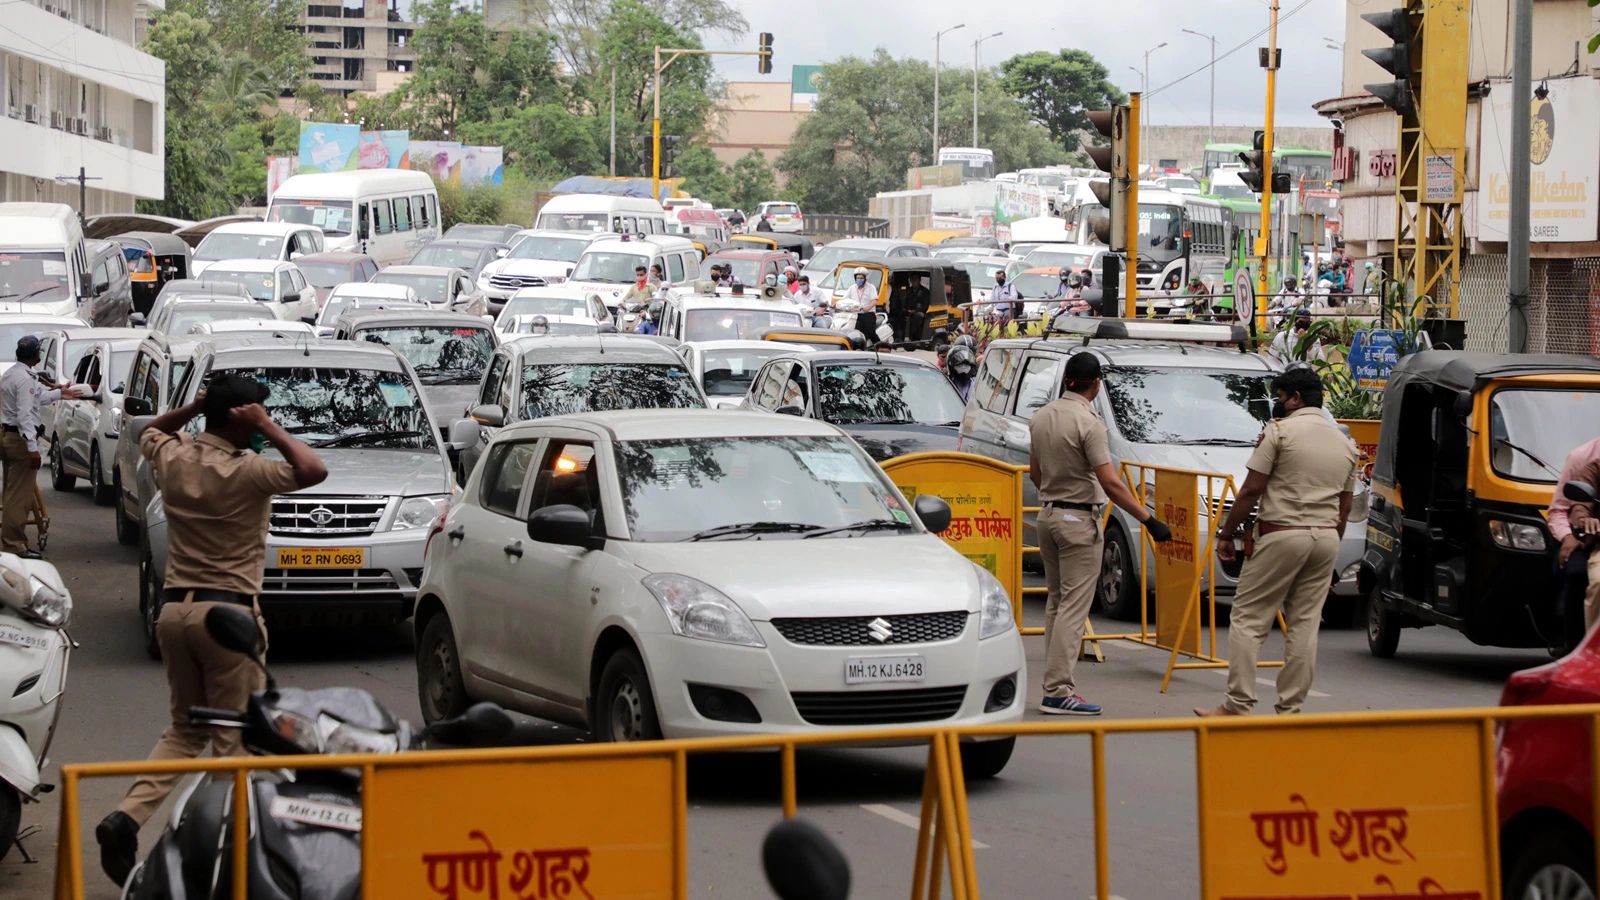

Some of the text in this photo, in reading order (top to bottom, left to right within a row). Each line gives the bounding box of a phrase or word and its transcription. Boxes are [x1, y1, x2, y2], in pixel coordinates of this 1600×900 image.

[1533, 226, 1559, 238] SAREES
[280, 554, 362, 565] MH 12 RN 0693
[1250, 793, 1417, 876] पुणे शहर
[422, 829, 596, 900] पणे शहर
